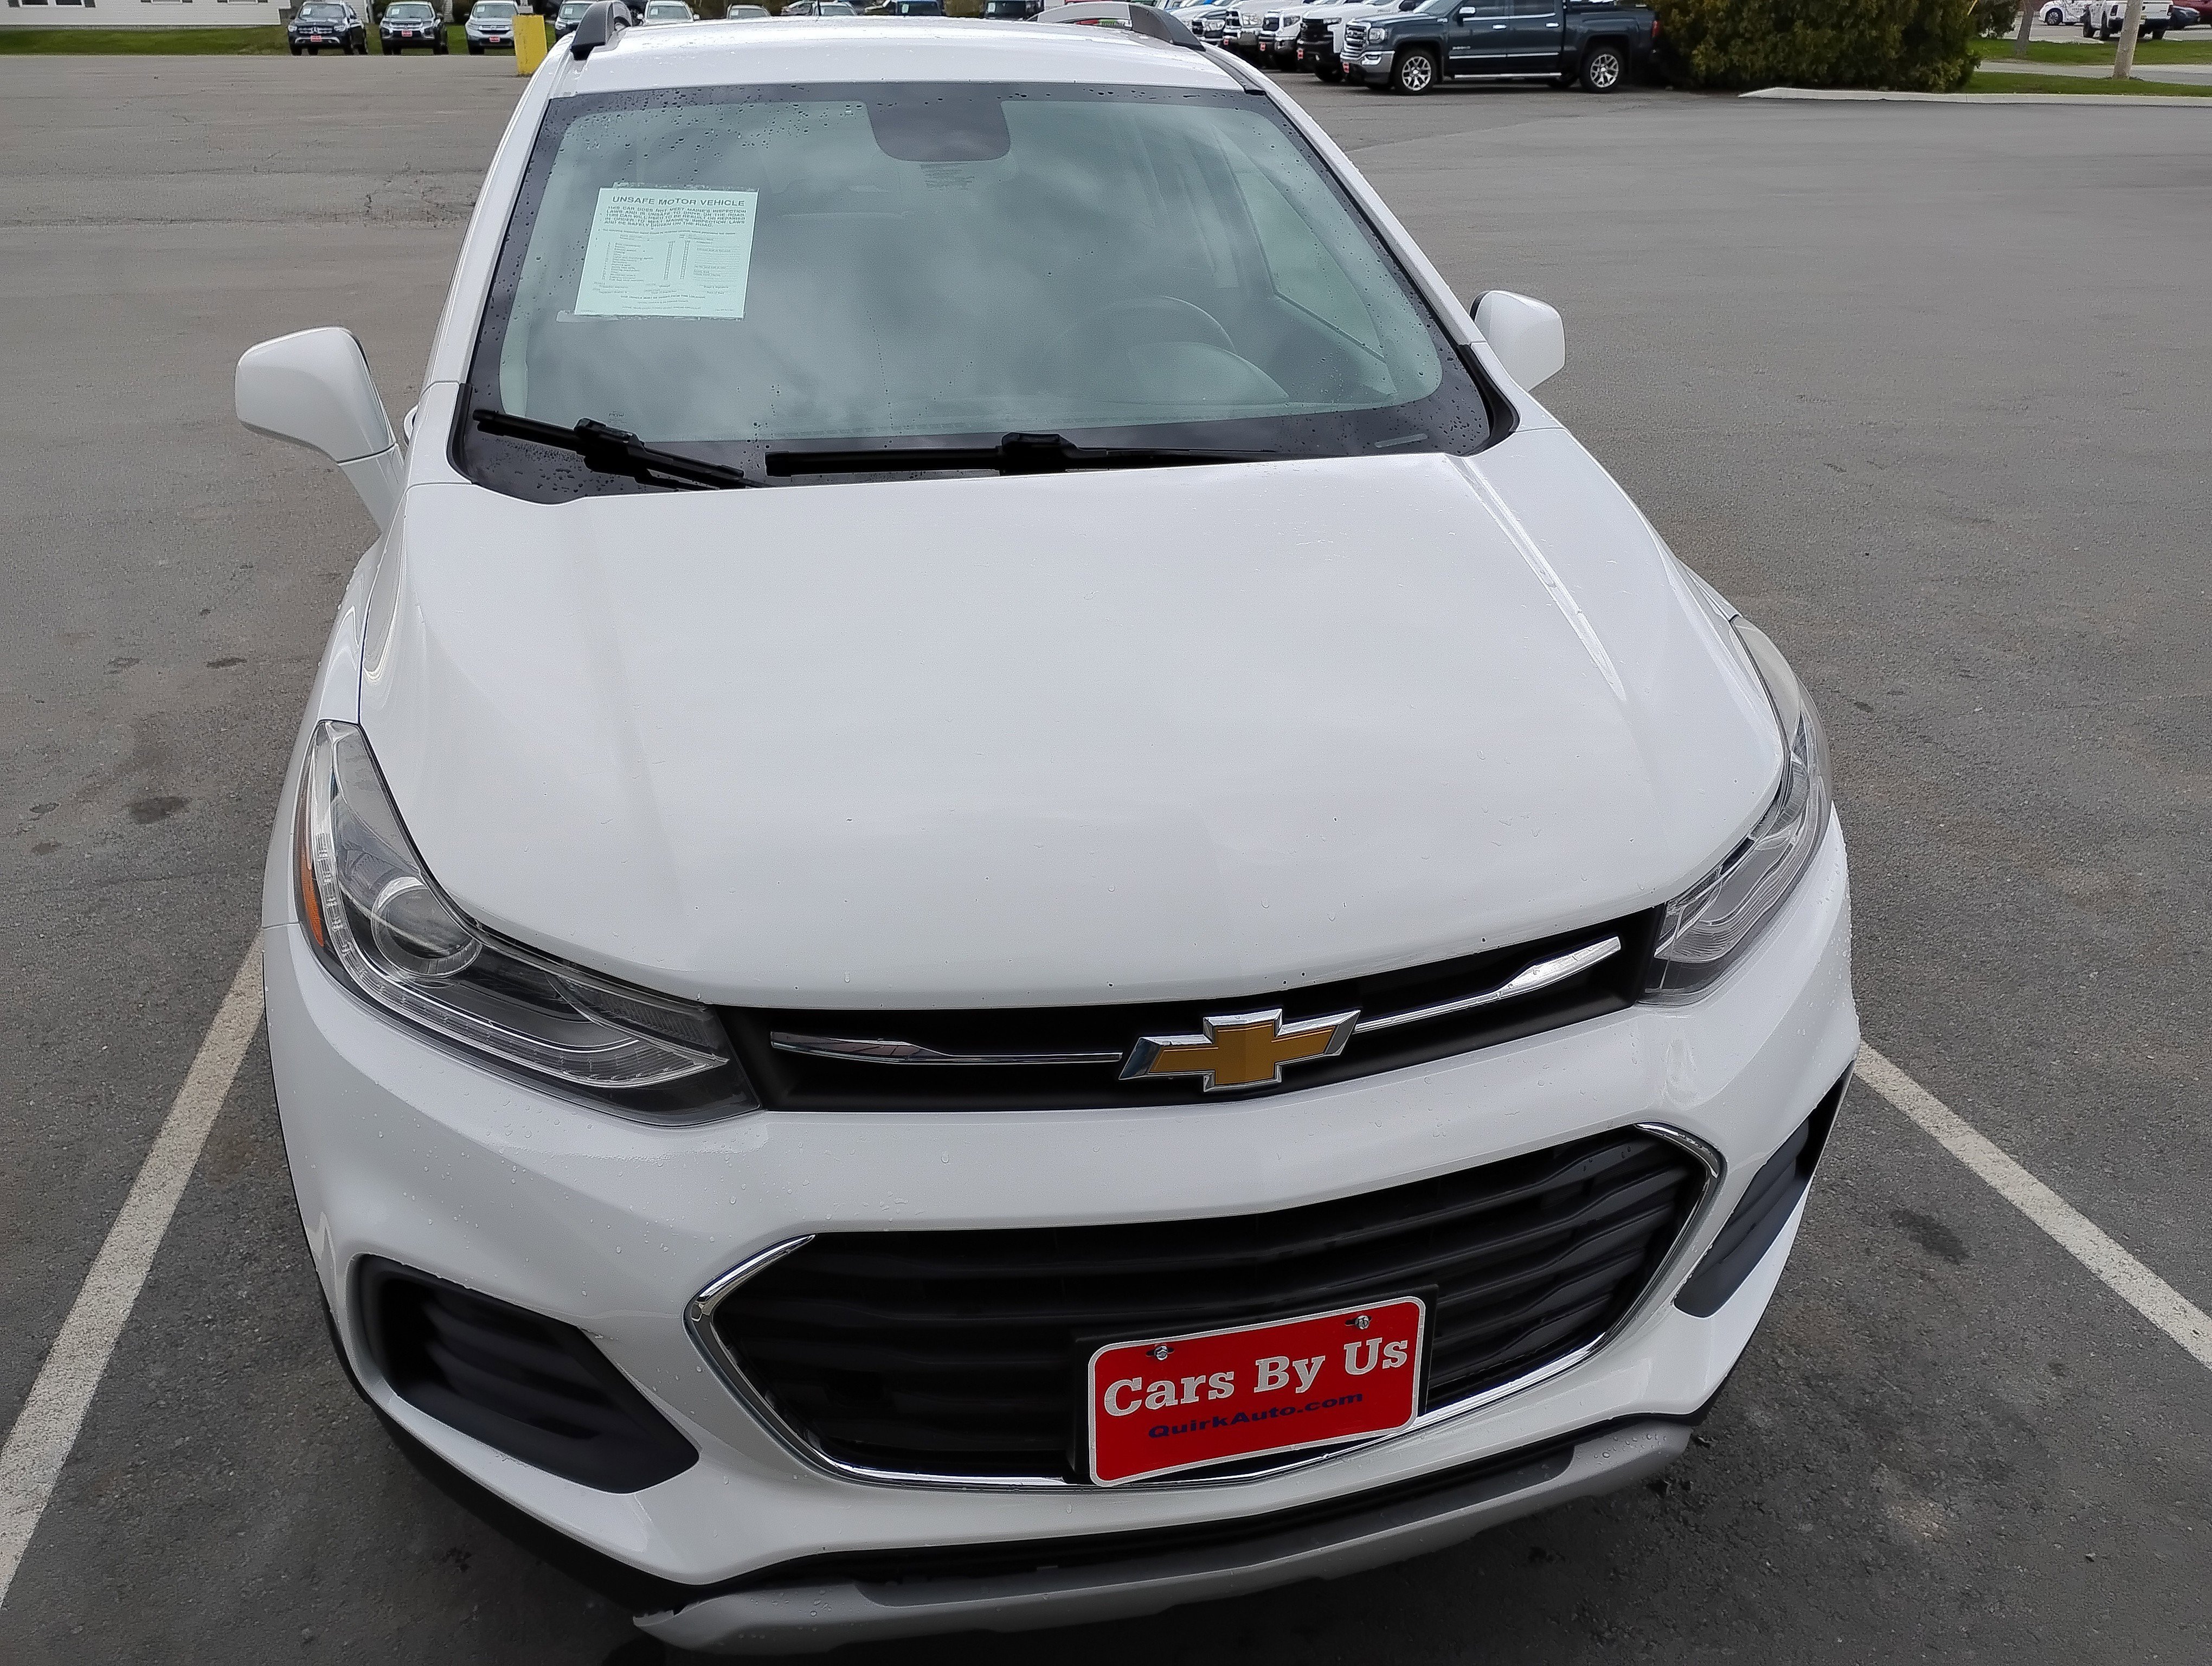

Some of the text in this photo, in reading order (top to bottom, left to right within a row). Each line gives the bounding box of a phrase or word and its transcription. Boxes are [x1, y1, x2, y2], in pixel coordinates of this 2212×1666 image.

[613, 196, 655, 204] UNSAFE
[1104, 1337, 1408, 1417] Cars By Us
[1148, 1393, 1363, 1438] QuirkAuto.com
